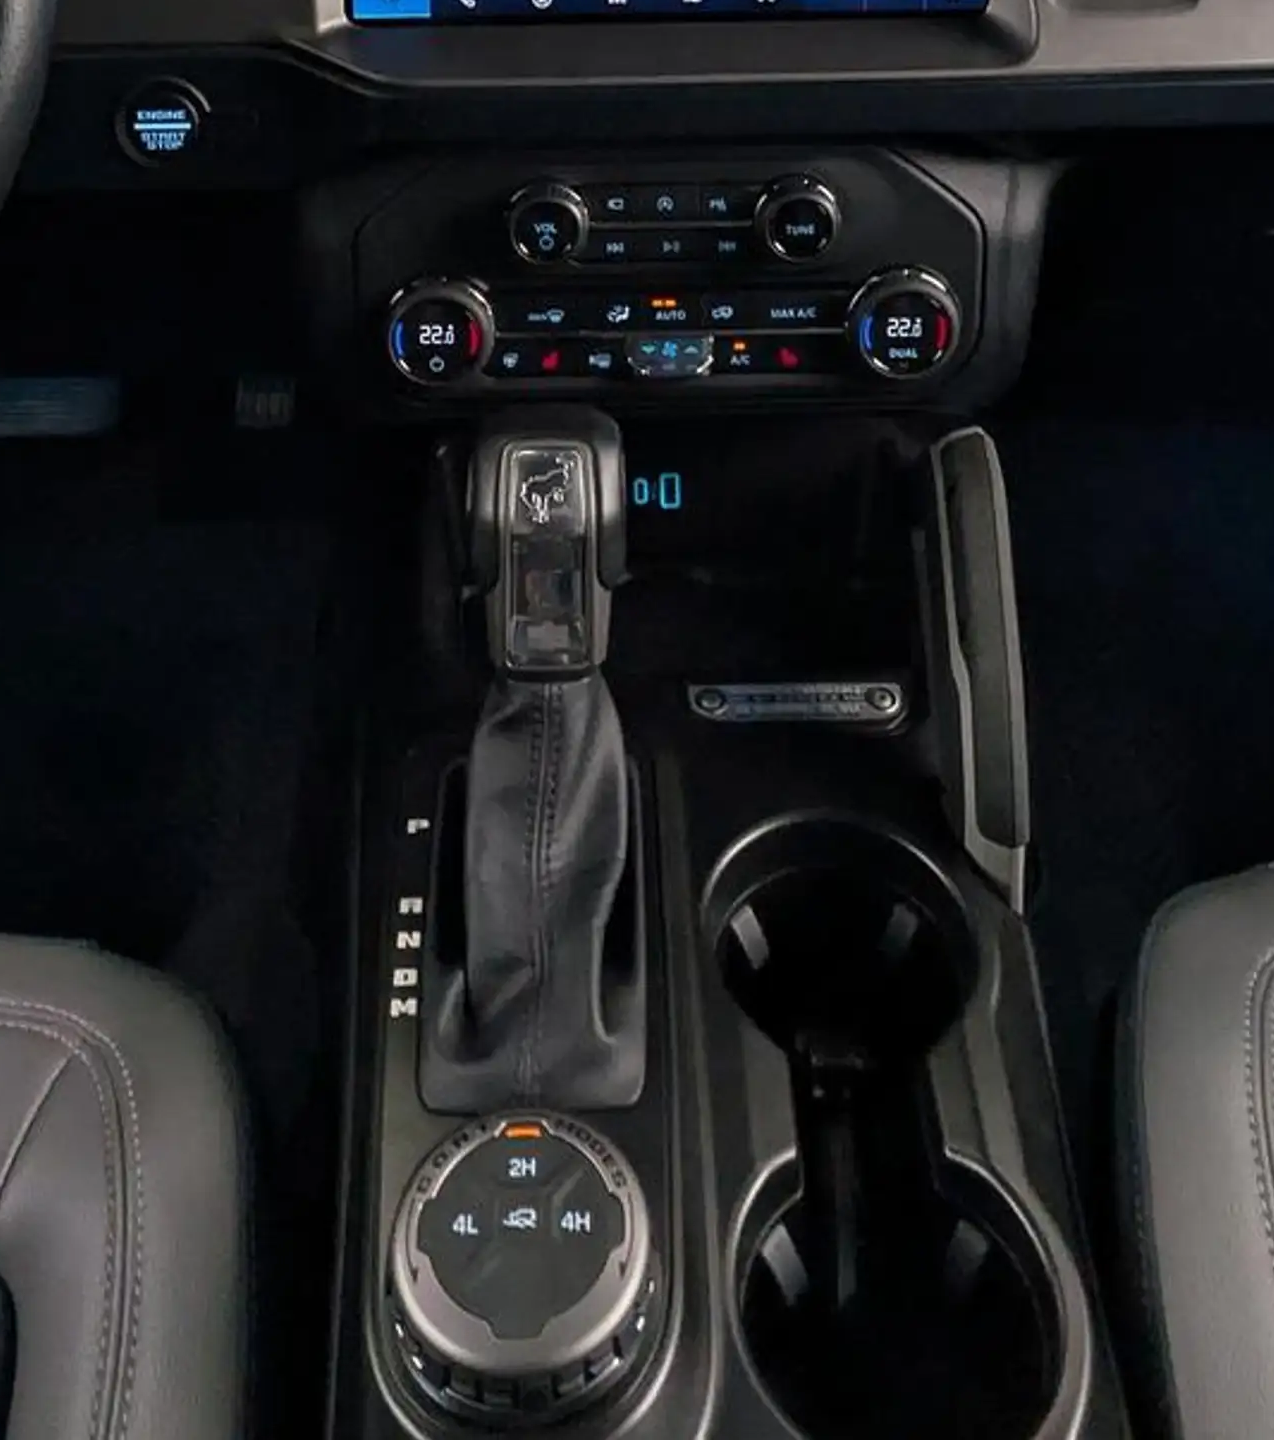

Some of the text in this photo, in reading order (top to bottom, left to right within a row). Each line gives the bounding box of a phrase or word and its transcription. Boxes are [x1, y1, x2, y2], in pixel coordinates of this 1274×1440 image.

[534, 222, 558, 234] VOL
[785, 225, 816, 236] TUNE
[655, 311, 687, 322] AUTO
[770, 307, 818, 319] MAX A/C
[730, 355, 751, 366] A/C
[889, 349, 919, 360] DUAL
[396, 930, 421, 950] N
[393, 967, 419, 987] D
[389, 997, 418, 1018] M
[507, 1156, 537, 1179] 2H
[451, 1212, 480, 1236] 4L
[560, 1211, 592, 1234] 4H
